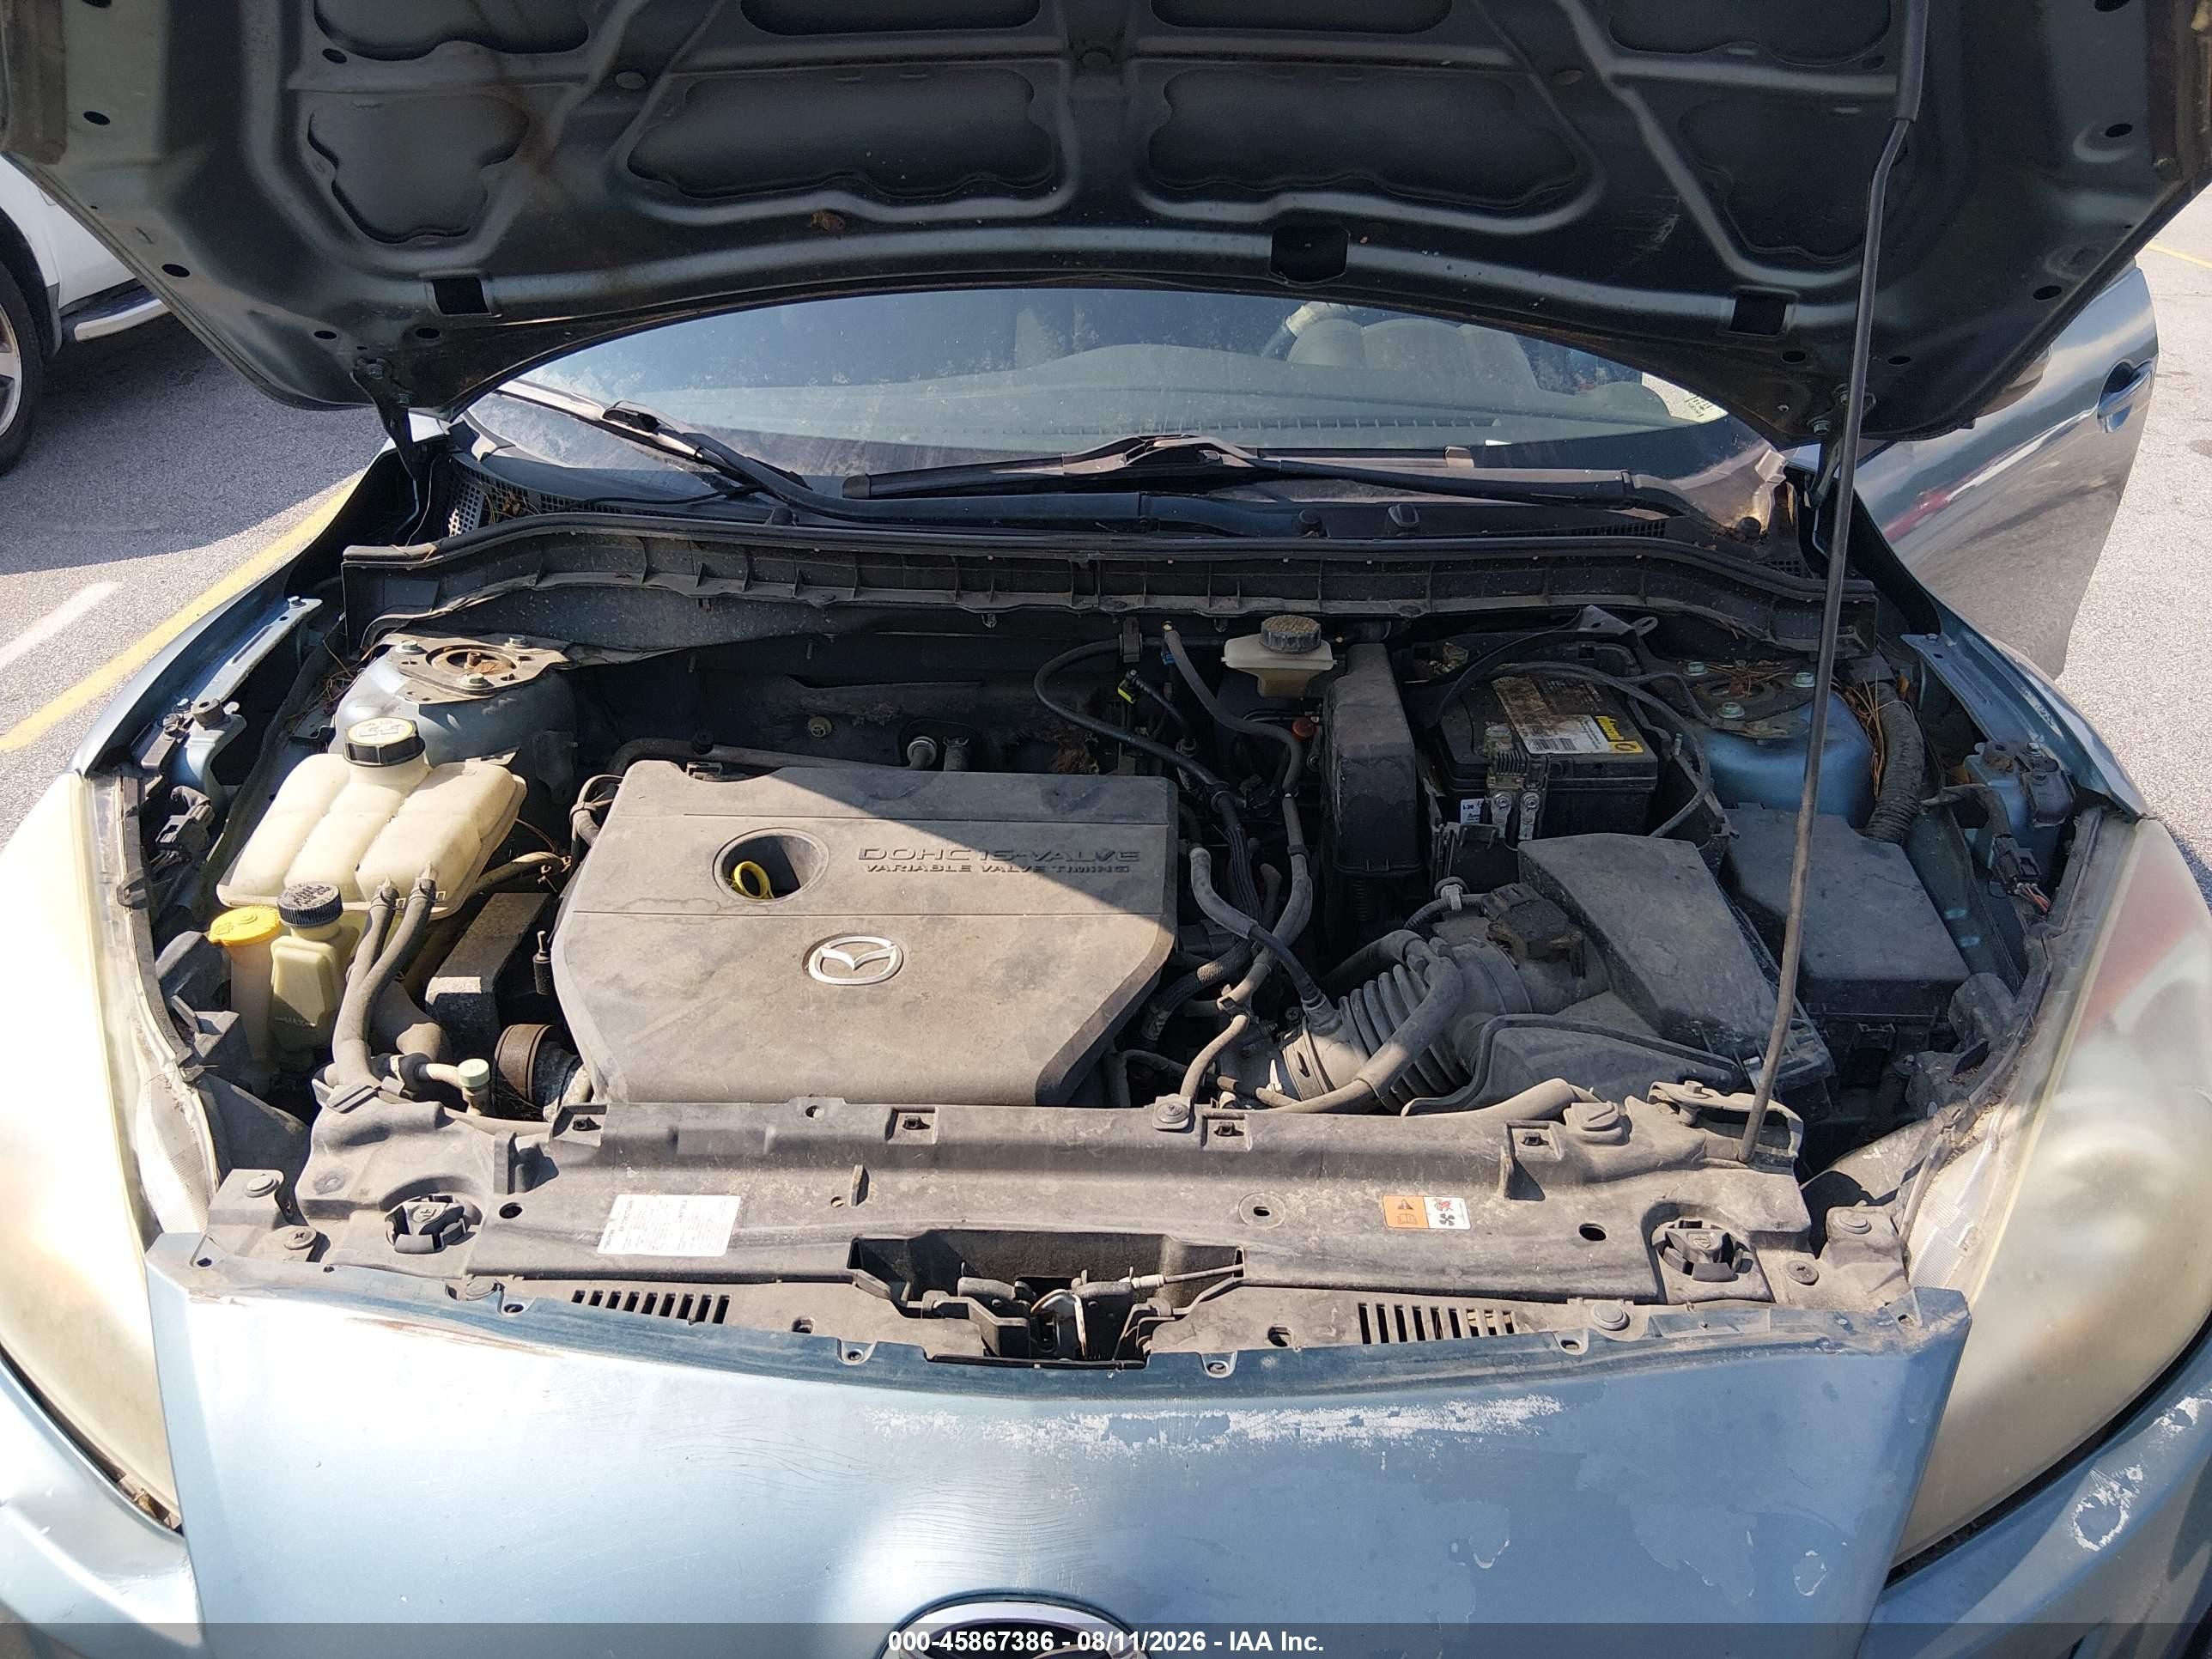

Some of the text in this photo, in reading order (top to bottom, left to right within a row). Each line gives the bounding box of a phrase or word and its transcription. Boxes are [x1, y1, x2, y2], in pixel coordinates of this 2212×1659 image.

[858, 848, 972, 861] DOHC
[866, 864, 1130, 873] VARIABLE VALVE TIMING
